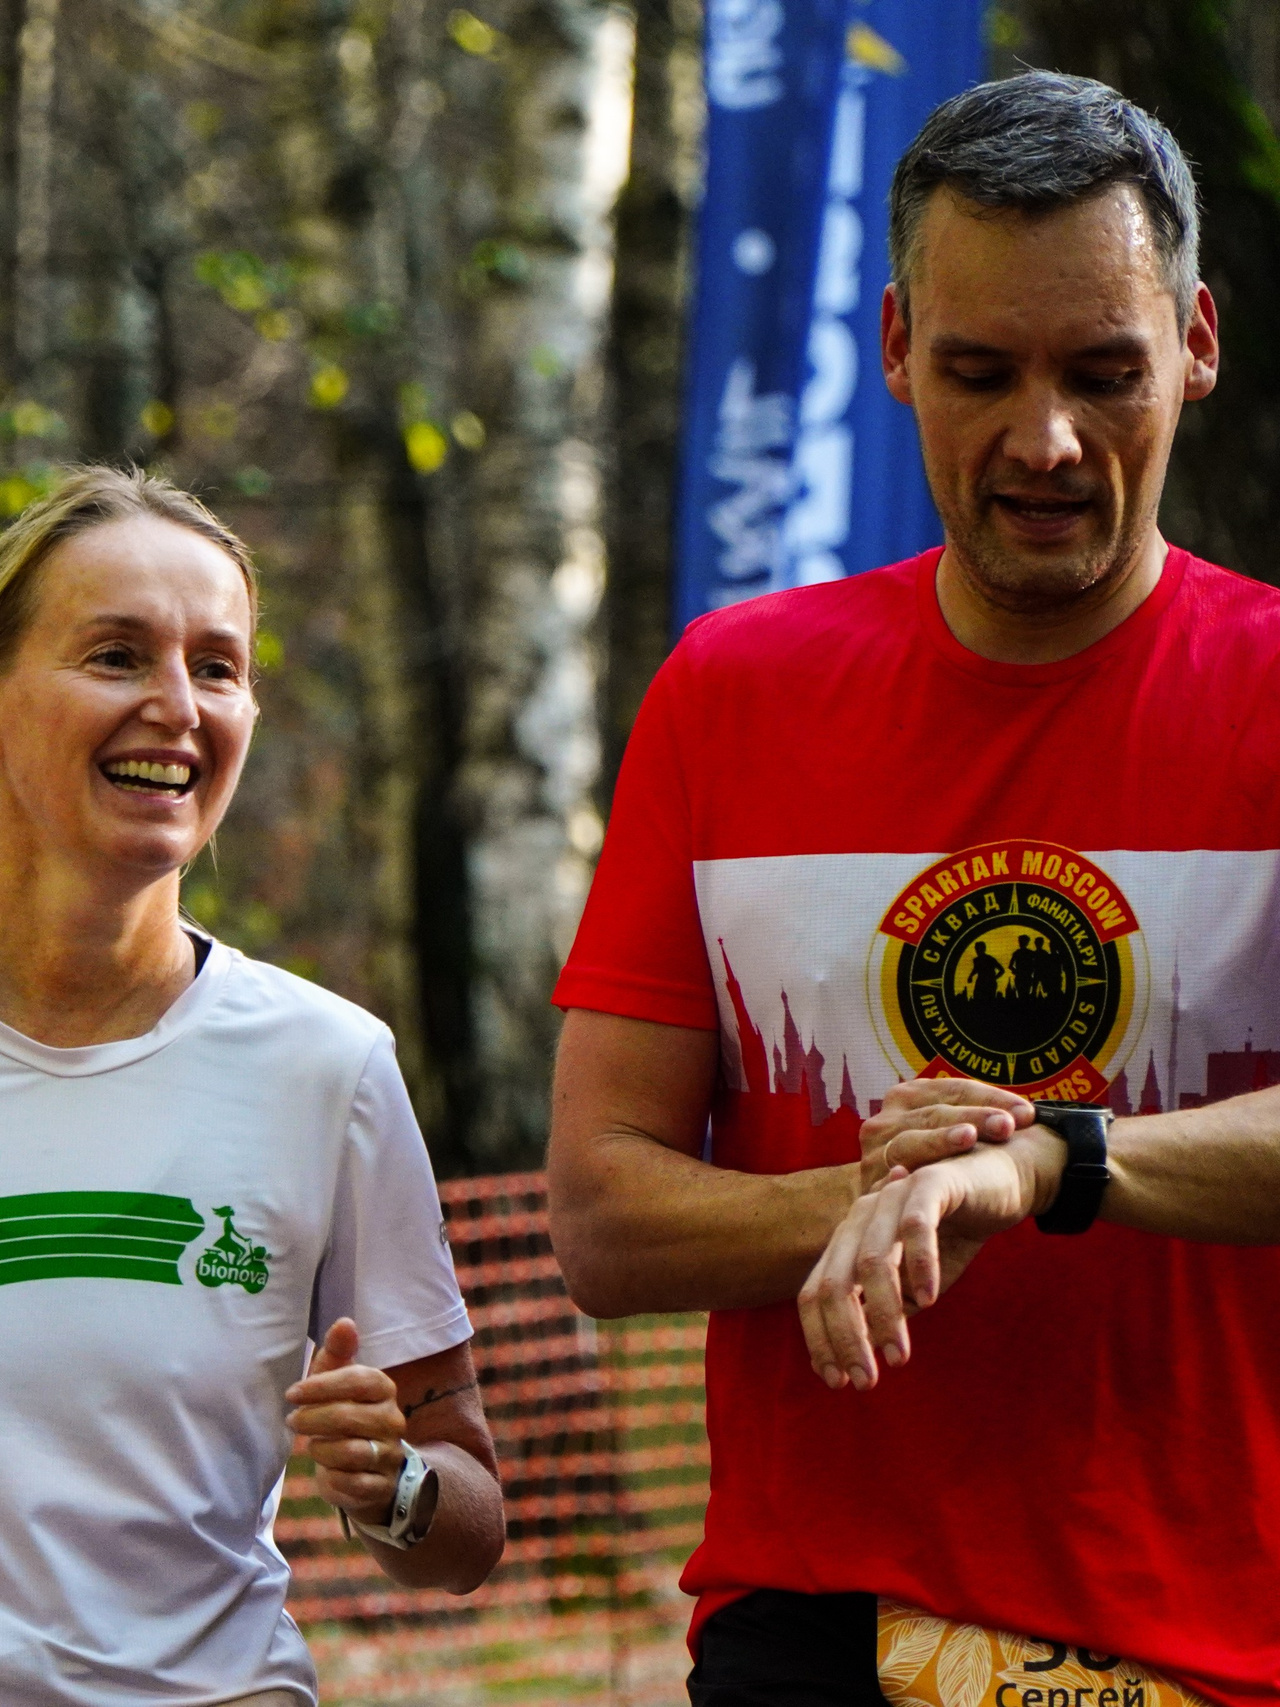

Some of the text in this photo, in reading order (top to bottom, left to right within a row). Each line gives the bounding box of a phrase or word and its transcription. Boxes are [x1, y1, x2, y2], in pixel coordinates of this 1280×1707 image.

[893, 850, 1126, 934] SPARTAK MOSCOW
[923, 892, 1000, 963] СКВАД
[1029, 1001, 1095, 1075] SQUAD
[198, 1257, 268, 1286] bionova
[995, 1678, 1145, 1707] Сергей
